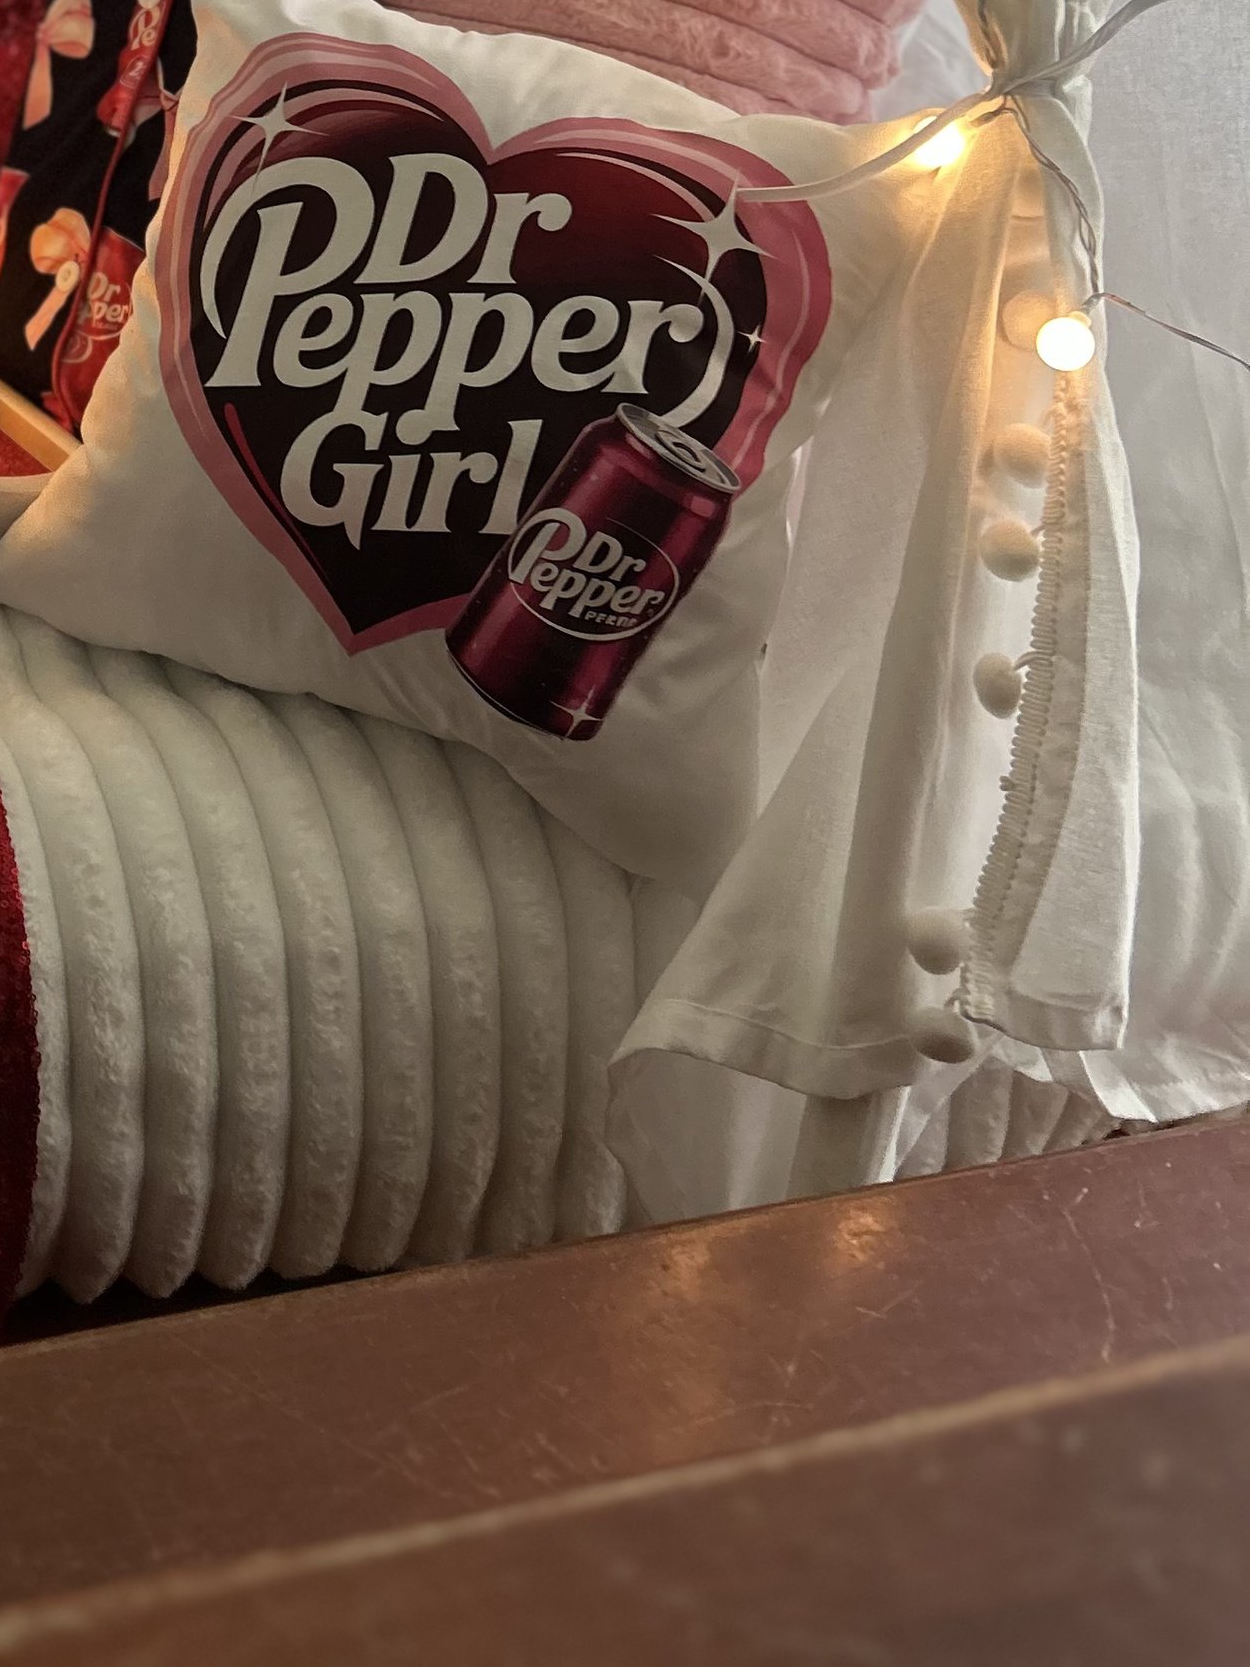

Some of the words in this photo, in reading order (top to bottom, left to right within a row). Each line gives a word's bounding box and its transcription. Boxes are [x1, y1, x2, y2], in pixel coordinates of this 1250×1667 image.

[354, 152, 572, 285] Dr
[200, 155, 706, 446] Pepper
[280, 414, 543, 551] Girl
[507, 507, 666, 618] Pepper
[572, 530, 647, 582] Dr
